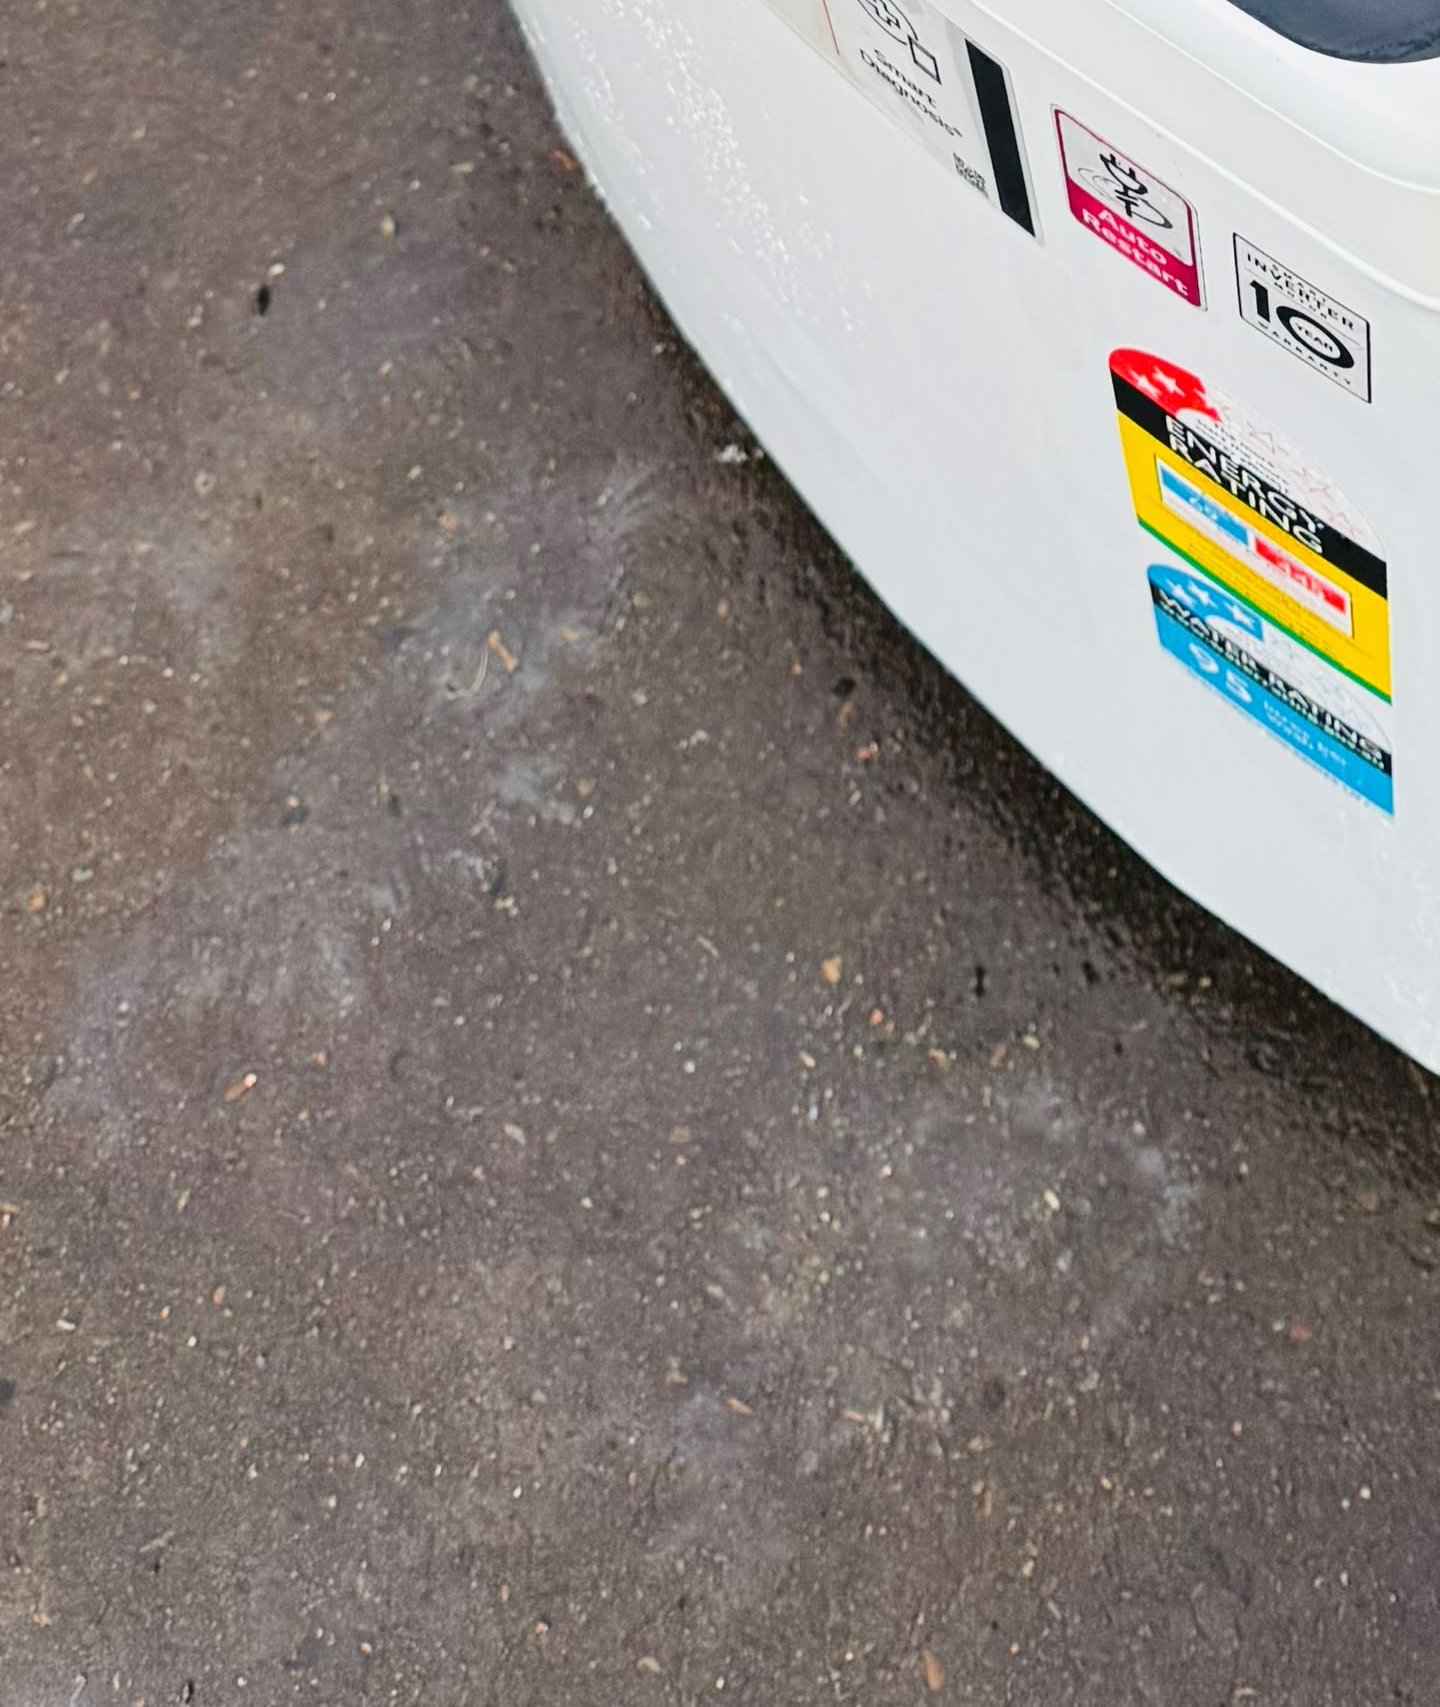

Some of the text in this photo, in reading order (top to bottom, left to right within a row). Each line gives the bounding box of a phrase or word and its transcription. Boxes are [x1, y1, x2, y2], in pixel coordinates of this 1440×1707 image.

[874, 48, 938, 110] Smart
[1081, 207, 1188, 298] Restart
[1098, 206, 1167, 268] Auto
[1247, 252, 1355, 332] INVERTER
[1272, 263, 1328, 305] SMART
[1249, 279, 1355, 370] 10
[1257, 320, 1353, 386] WARRANTY
[1295, 321, 1334, 354] YEAR
[1165, 413, 1322, 533] ENERGY
[1168, 433, 1324, 555] RATING
[1158, 587, 1259, 672] WATER
[1267, 670, 1384, 762] RATING
